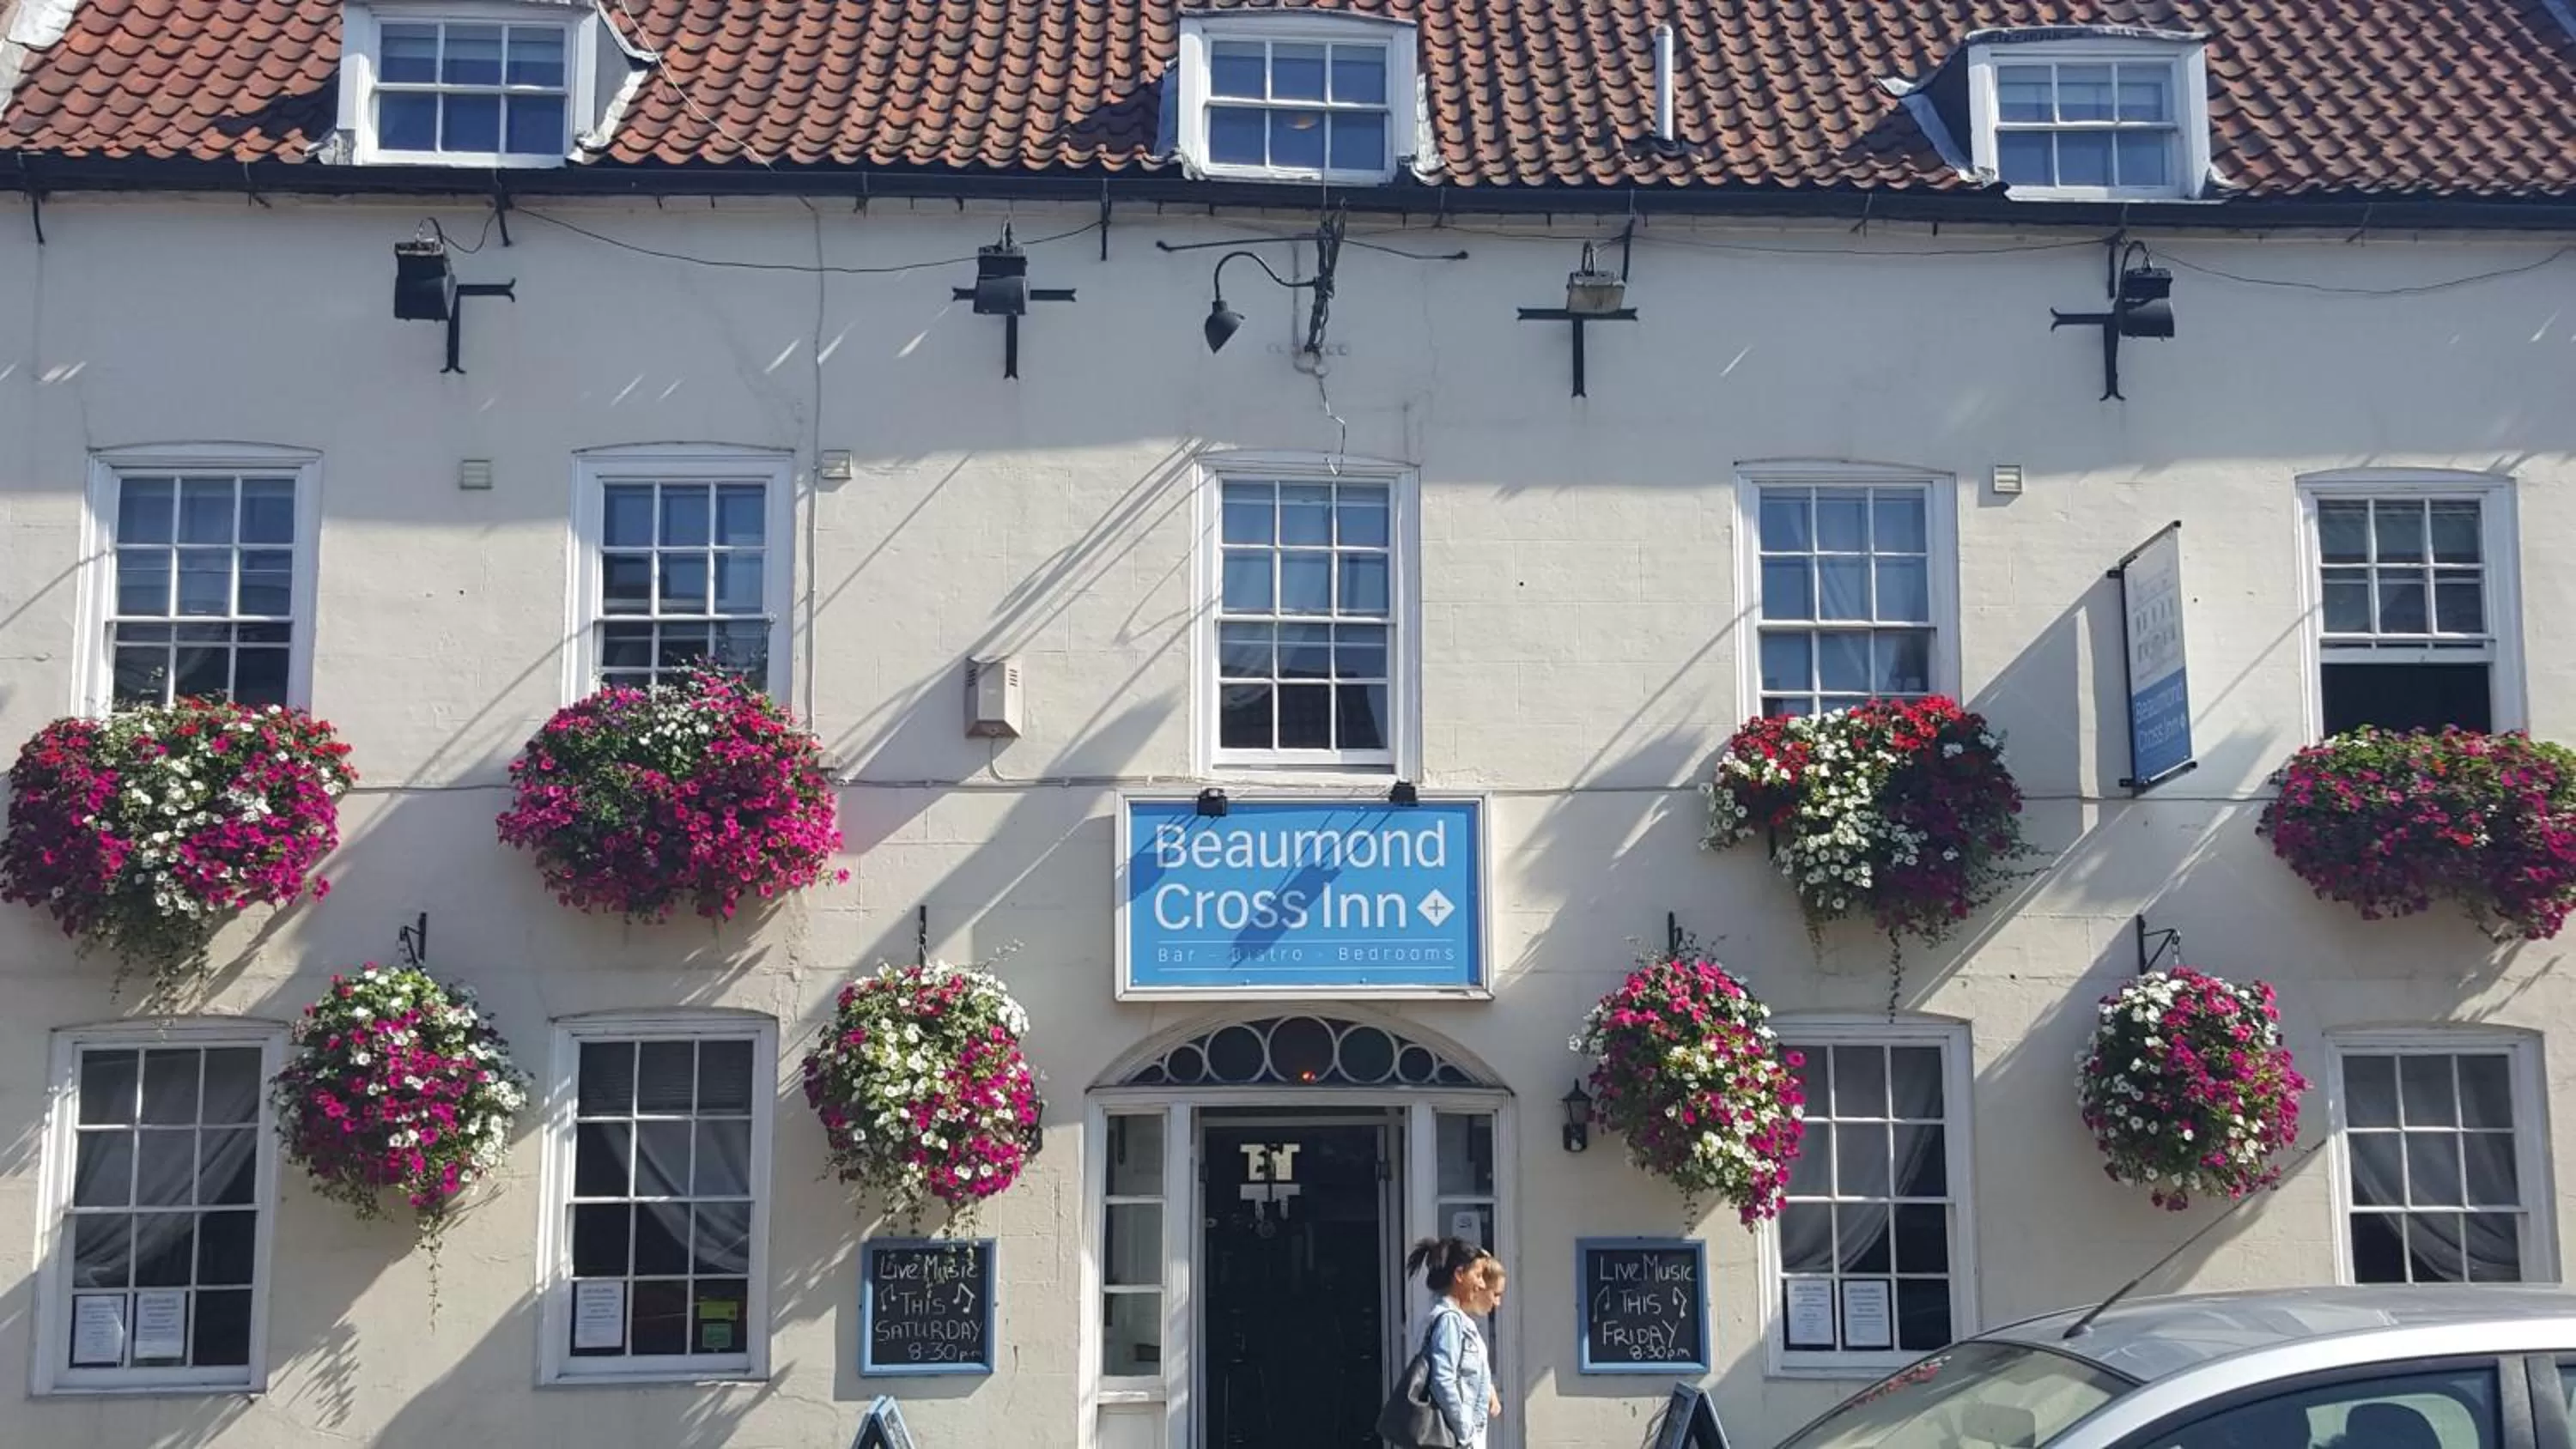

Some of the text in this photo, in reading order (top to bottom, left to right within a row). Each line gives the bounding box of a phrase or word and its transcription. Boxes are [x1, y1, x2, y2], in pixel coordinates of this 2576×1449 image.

[1155, 819, 1446, 870] Beaumond
[1154, 882, 1407, 931] Cross Inn
[1157, 946, 1456, 962] Bar Bistro Bedrooms
[1603, 1319, 1680, 1348] FRIDAY
